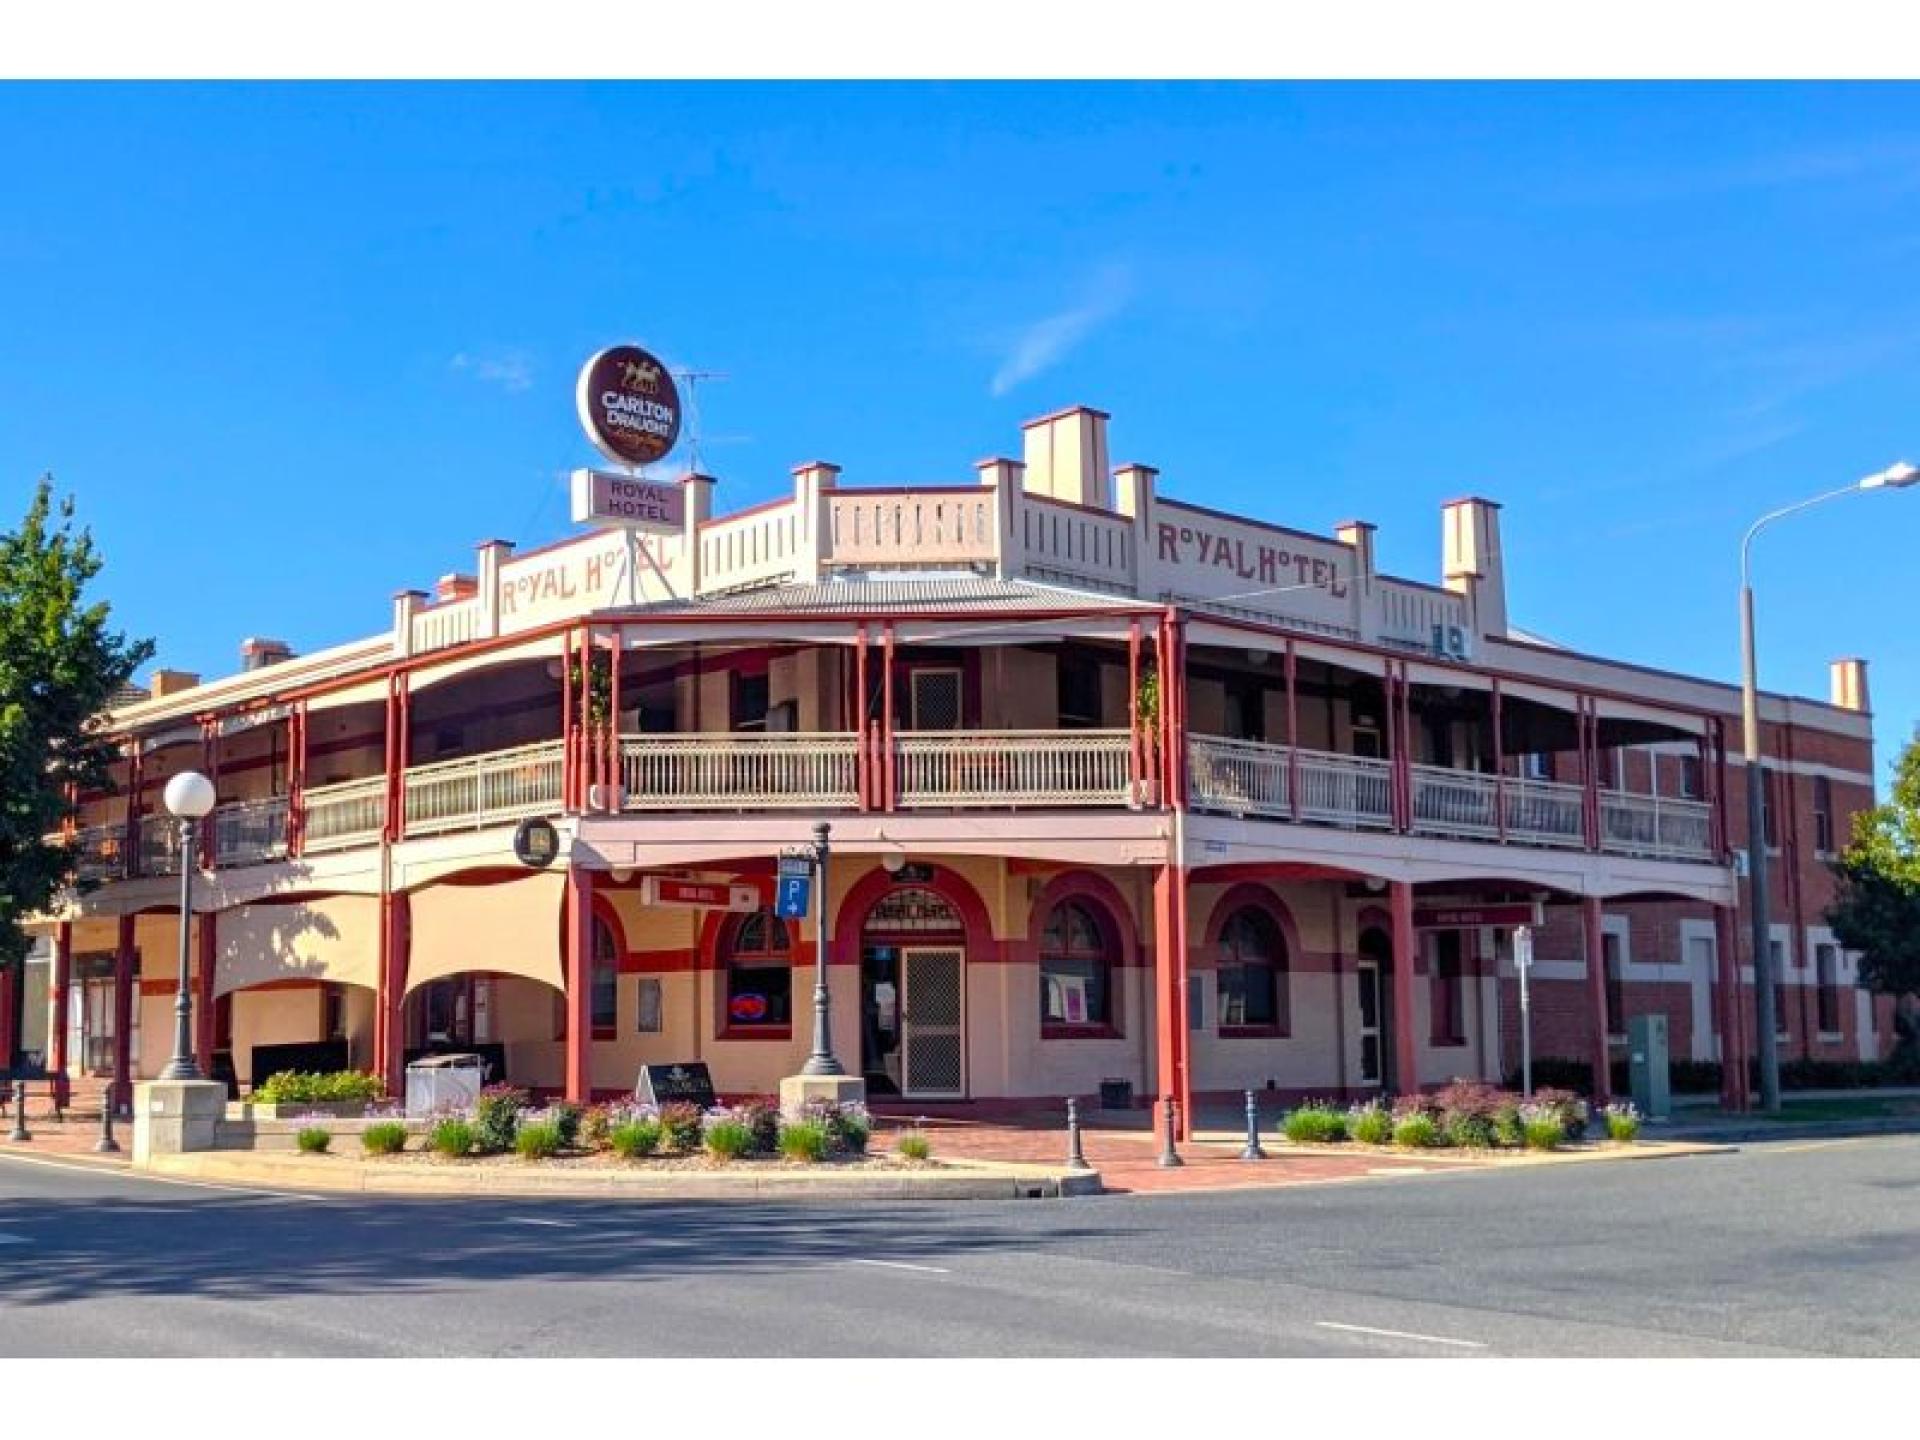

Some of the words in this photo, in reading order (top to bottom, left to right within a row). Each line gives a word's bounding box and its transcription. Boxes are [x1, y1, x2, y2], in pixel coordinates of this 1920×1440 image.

[602, 391, 673, 425] CARLTON
[607, 410, 669, 436] DRAUGHT
[611, 480, 667, 502] ROYAL
[608, 499, 670, 521] HOTEL
[586, 534, 673, 593] HOEL
